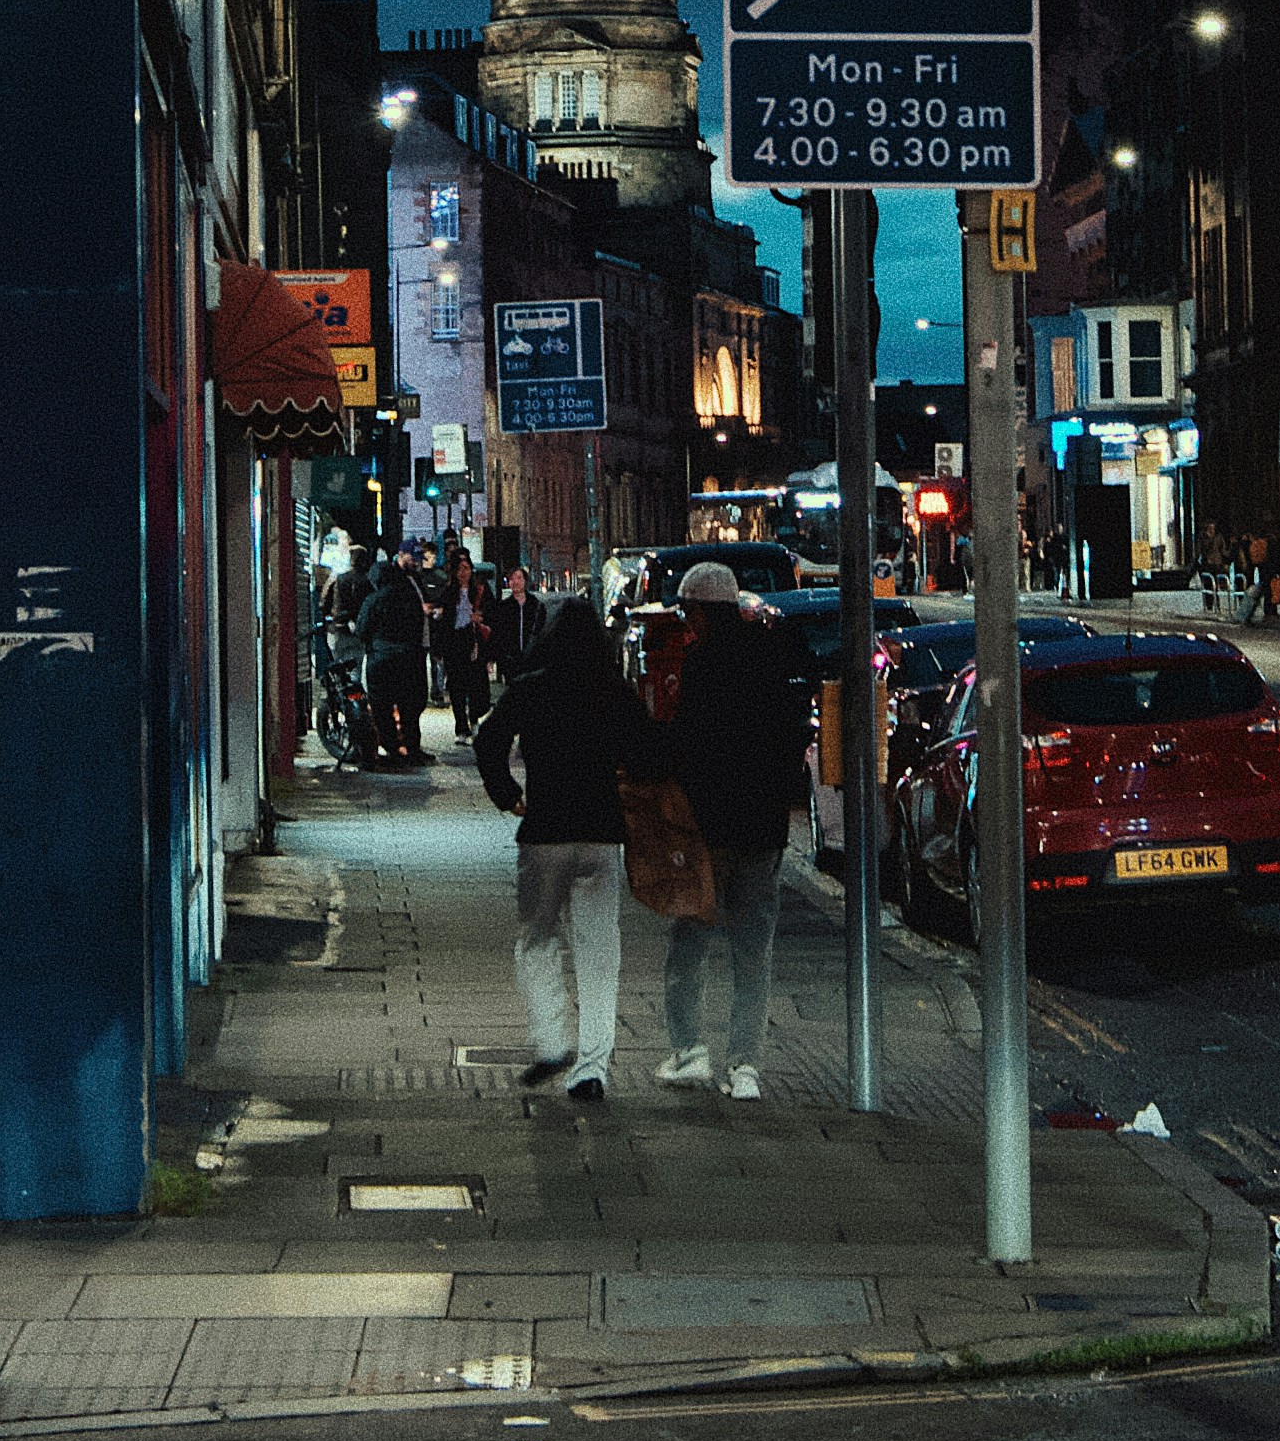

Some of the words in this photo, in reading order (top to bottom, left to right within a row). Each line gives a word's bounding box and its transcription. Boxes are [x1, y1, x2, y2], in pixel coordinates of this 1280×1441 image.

[809, 53, 883, 84] Mon
[915, 54, 958, 85] Fri
[1124, 853, 1175, 873] LF64
[1180, 850, 1218, 869] GWK
